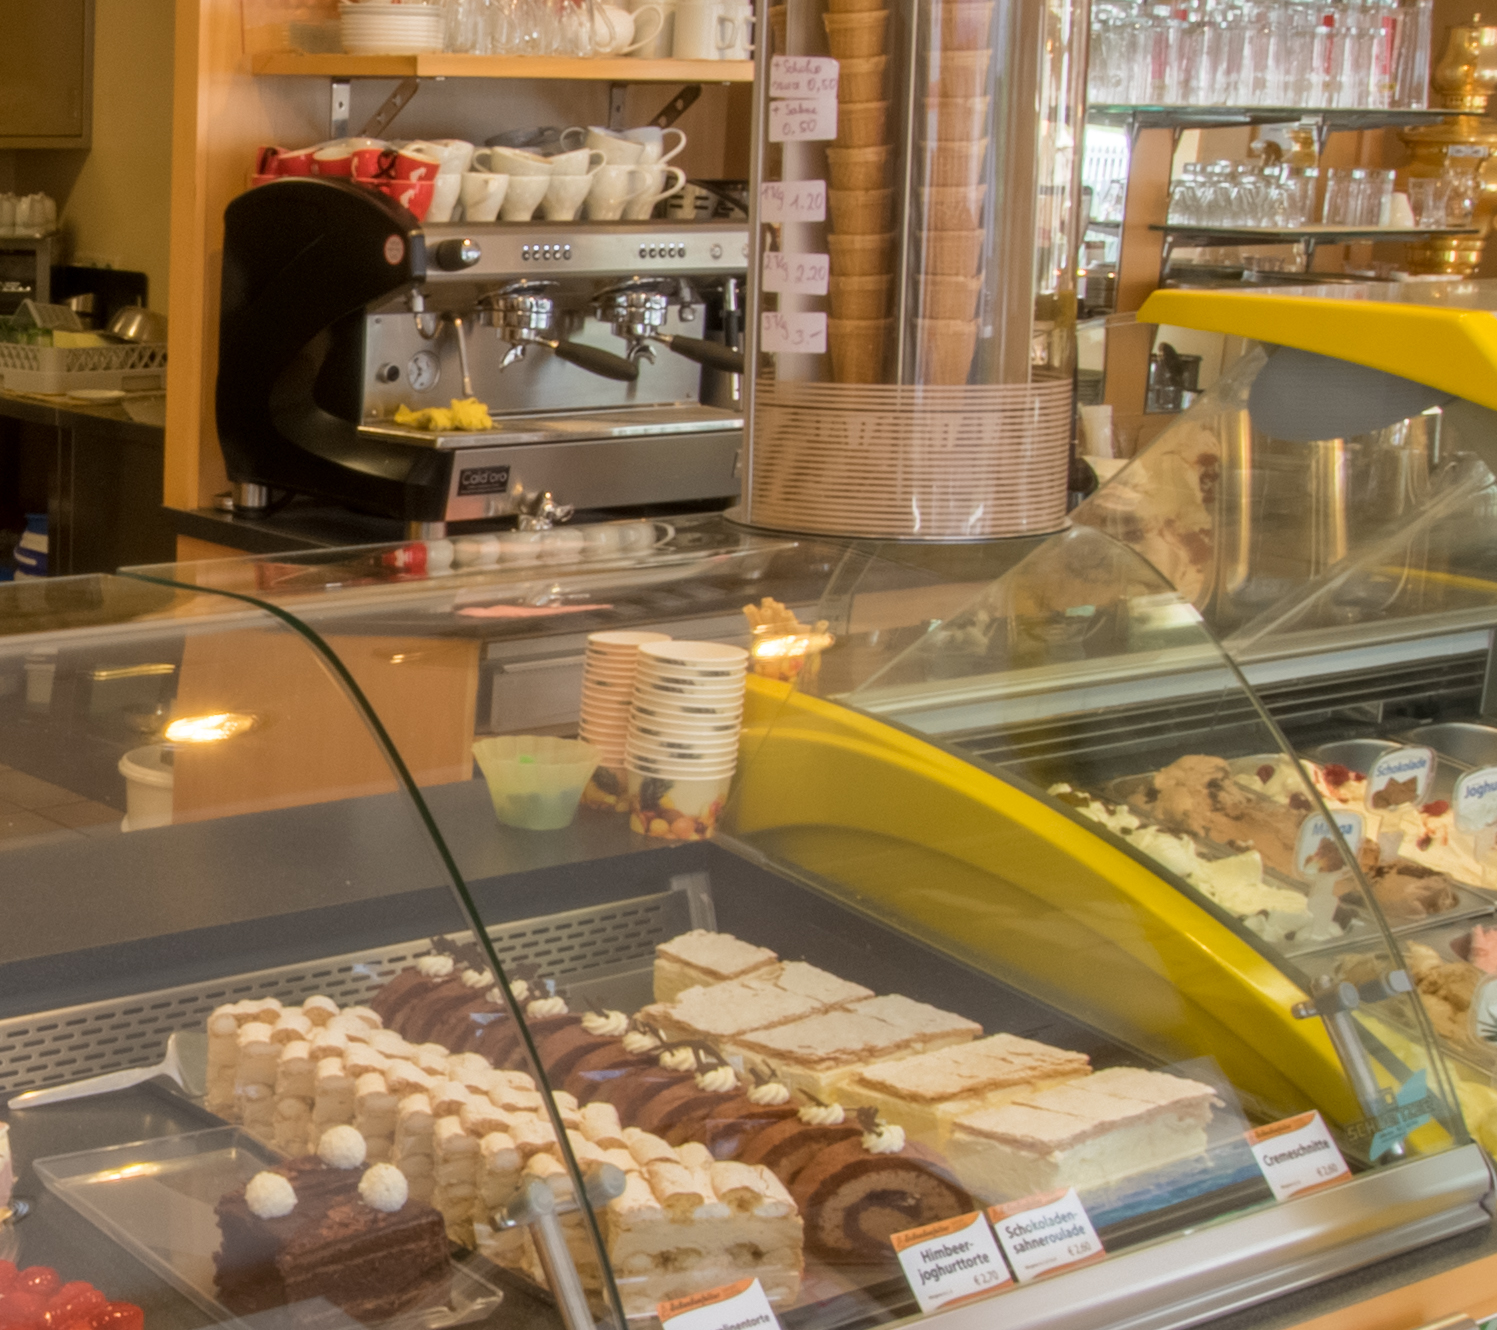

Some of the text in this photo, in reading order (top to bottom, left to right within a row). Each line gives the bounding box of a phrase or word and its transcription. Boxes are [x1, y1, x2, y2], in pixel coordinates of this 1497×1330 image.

[1262, 1137, 1331, 1167] Cremeschnitte
[1005, 1210, 1078, 1239] Schokoladen-
[1013, 1224, 1086, 1254] sahneroulade
[920, 1240, 974, 1263] Himbeer-
[918, 1252, 990, 1286] joghurttorte
